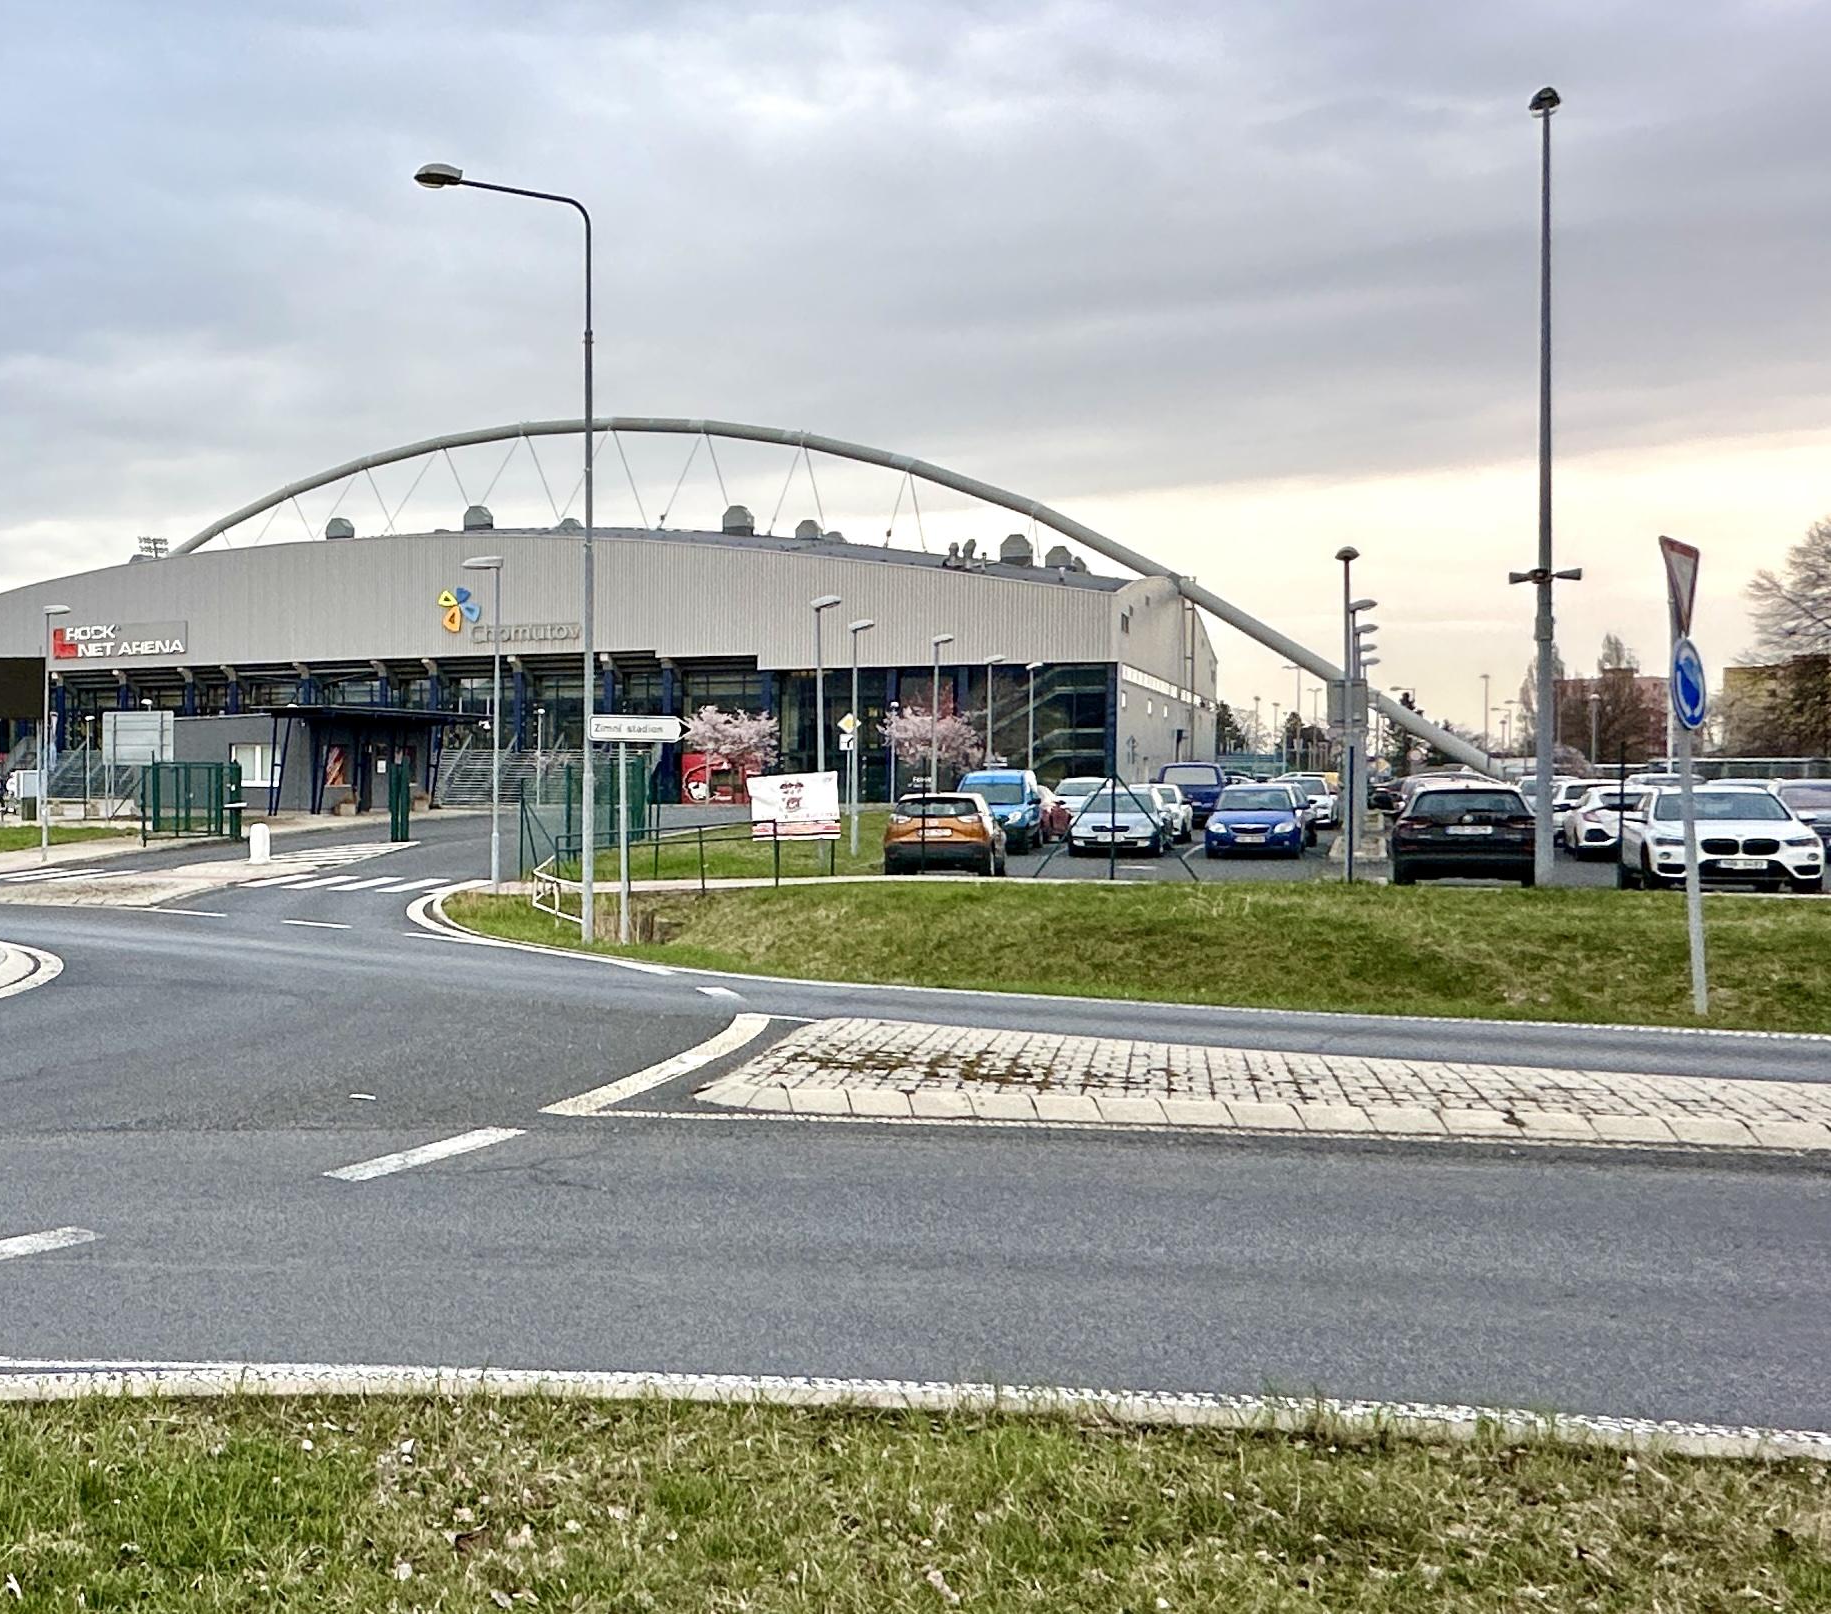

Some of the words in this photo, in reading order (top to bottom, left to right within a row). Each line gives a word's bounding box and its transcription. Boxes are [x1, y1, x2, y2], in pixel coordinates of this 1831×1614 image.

[472, 623, 580, 644] Chomutov
[77, 642, 115, 658] NET
[118, 640, 185, 657] ARENA
